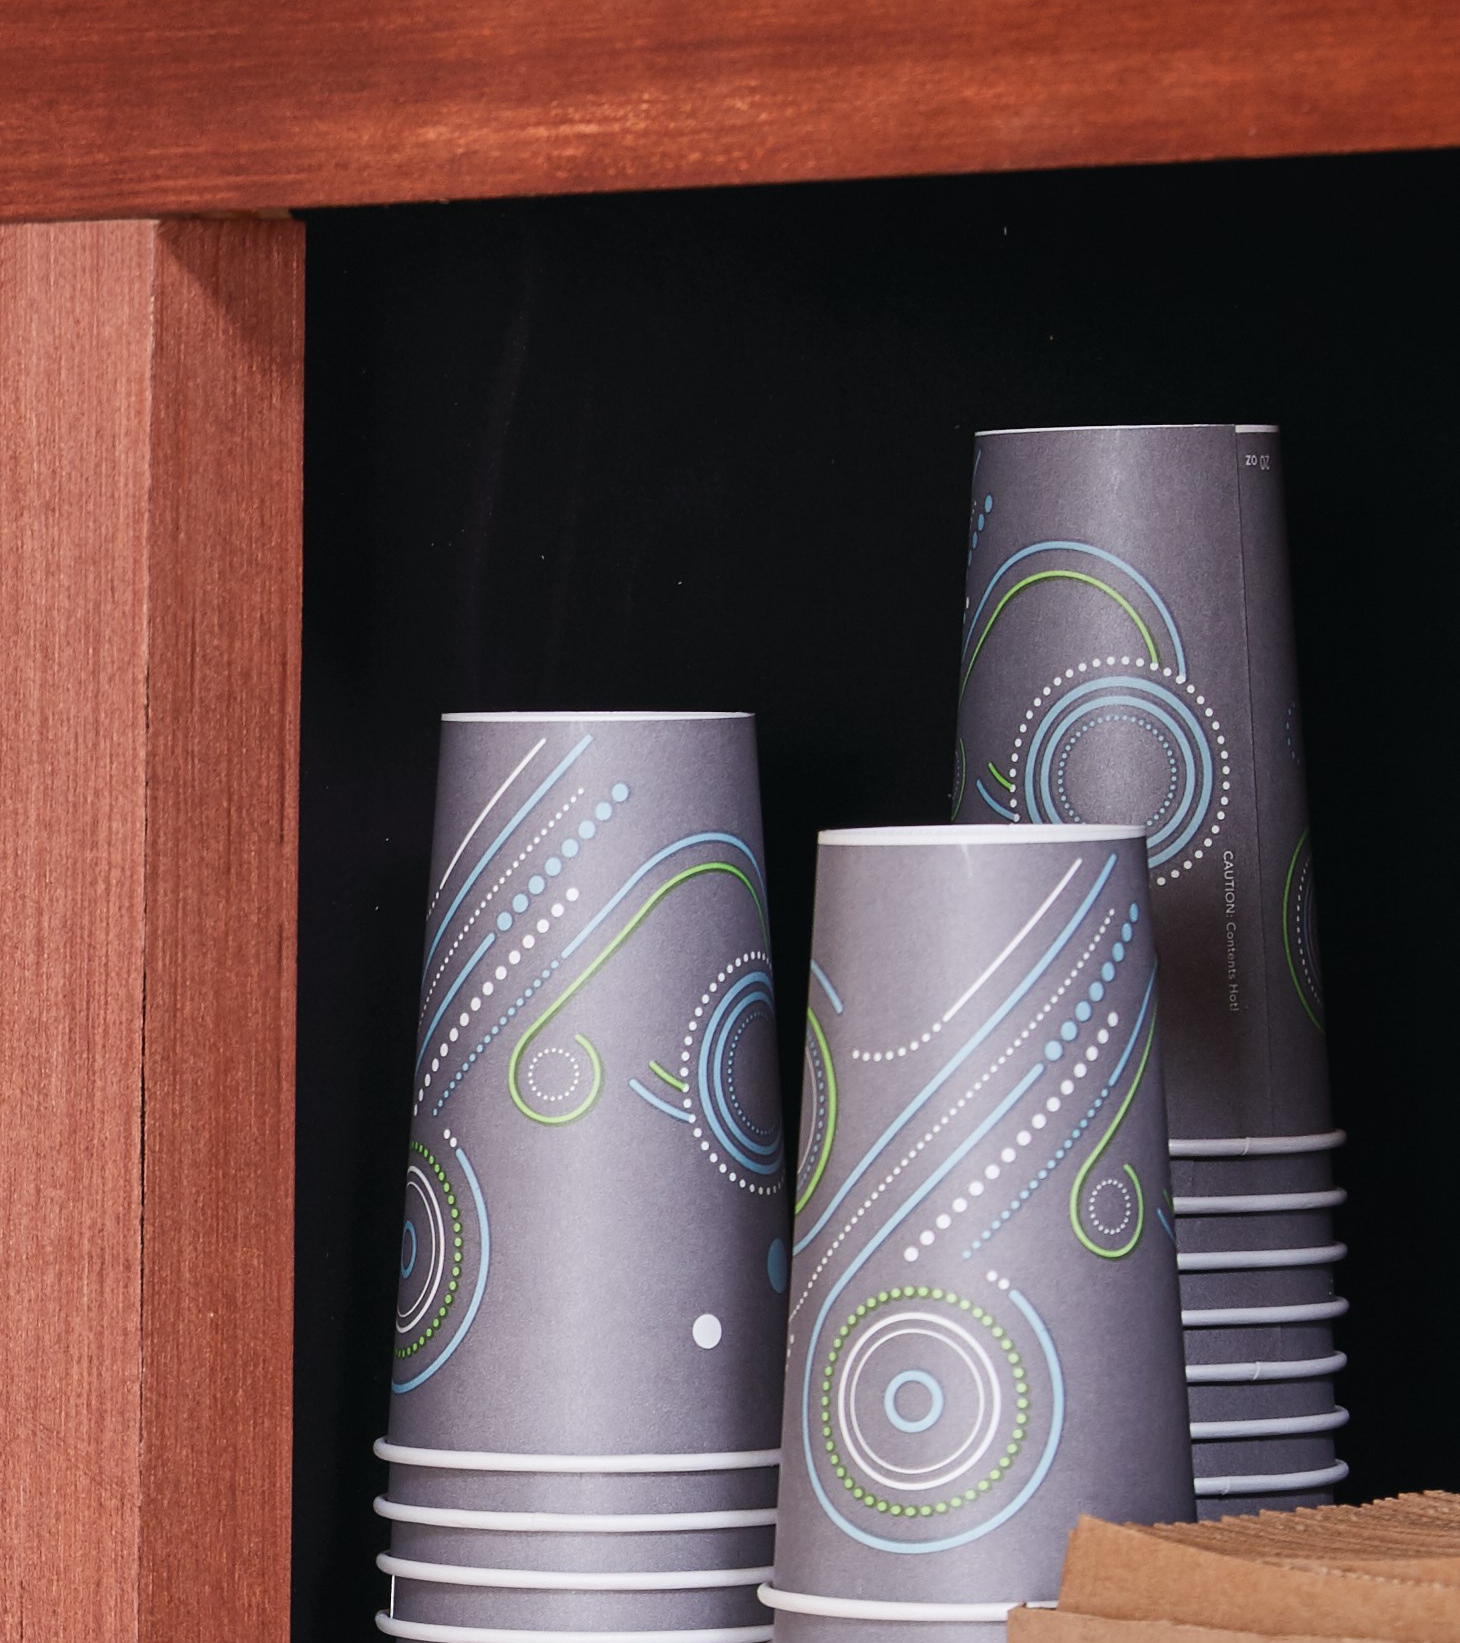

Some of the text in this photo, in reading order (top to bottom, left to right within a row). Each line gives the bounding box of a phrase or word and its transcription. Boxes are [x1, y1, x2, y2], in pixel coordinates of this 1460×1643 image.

[1245, 454, 1257, 466] oz
[1223, 850, 1239, 1011] CAUTION: Contents Hot!
